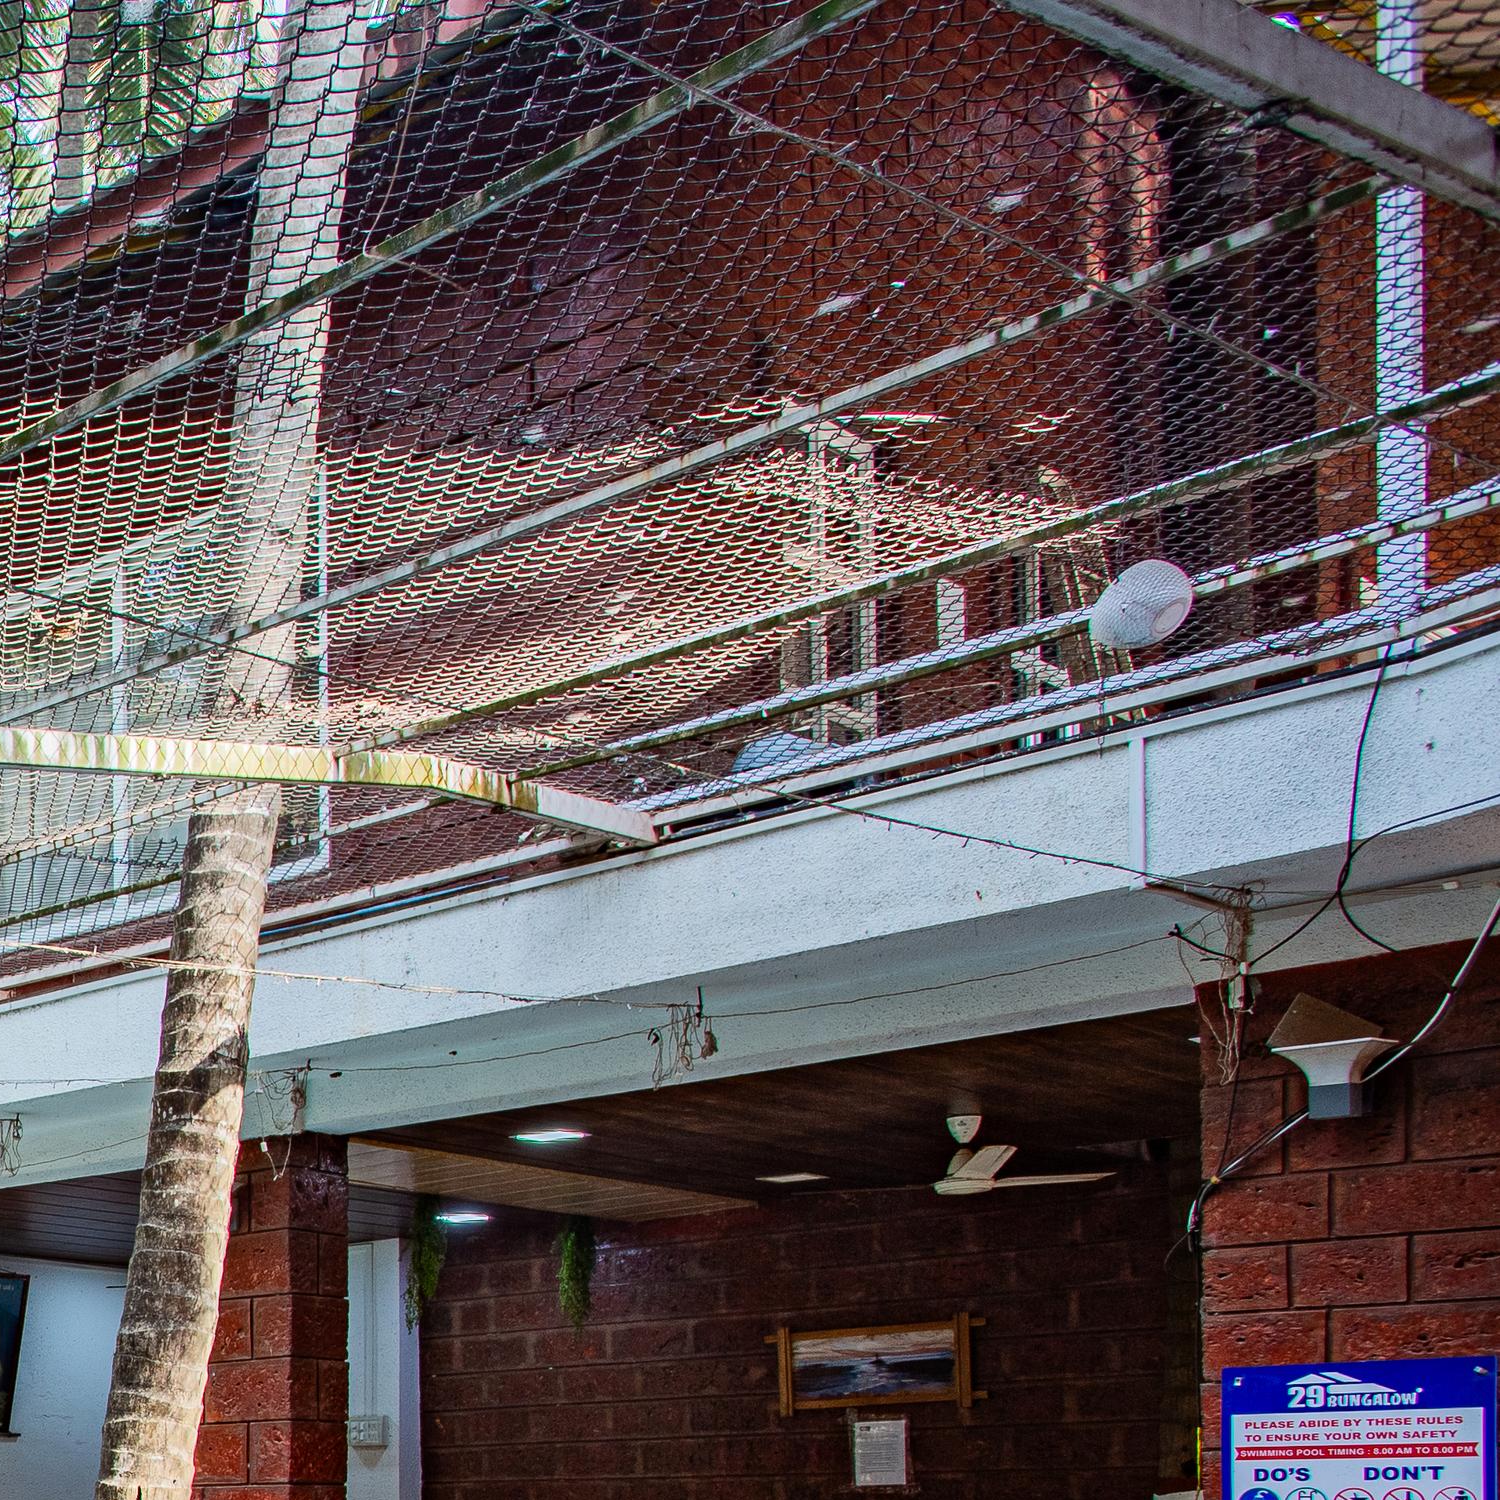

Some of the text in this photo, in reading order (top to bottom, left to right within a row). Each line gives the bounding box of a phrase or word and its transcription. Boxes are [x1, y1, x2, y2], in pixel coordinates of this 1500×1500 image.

[1287, 1385, 1418, 1408] 29 BUNGALOW
[1244, 1416, 1463, 1429] PLEASE ABIDE BY THESE RULES
[1244, 1430, 1457, 1442] TO ENSURE YOUR OWN SAFETY
[1240, 1449, 1293, 1457] SWIMMING
[1296, 1448, 1325, 1456] POOL
[1373, 1447, 1393, 1455] 8.00
[1416, 1446, 1430, 1454] TO
[1433, 1446, 1453, 1454] 8.00
[1253, 1467, 1310, 1482] DO'S
[1363, 1466, 1445, 1481] DON'T
